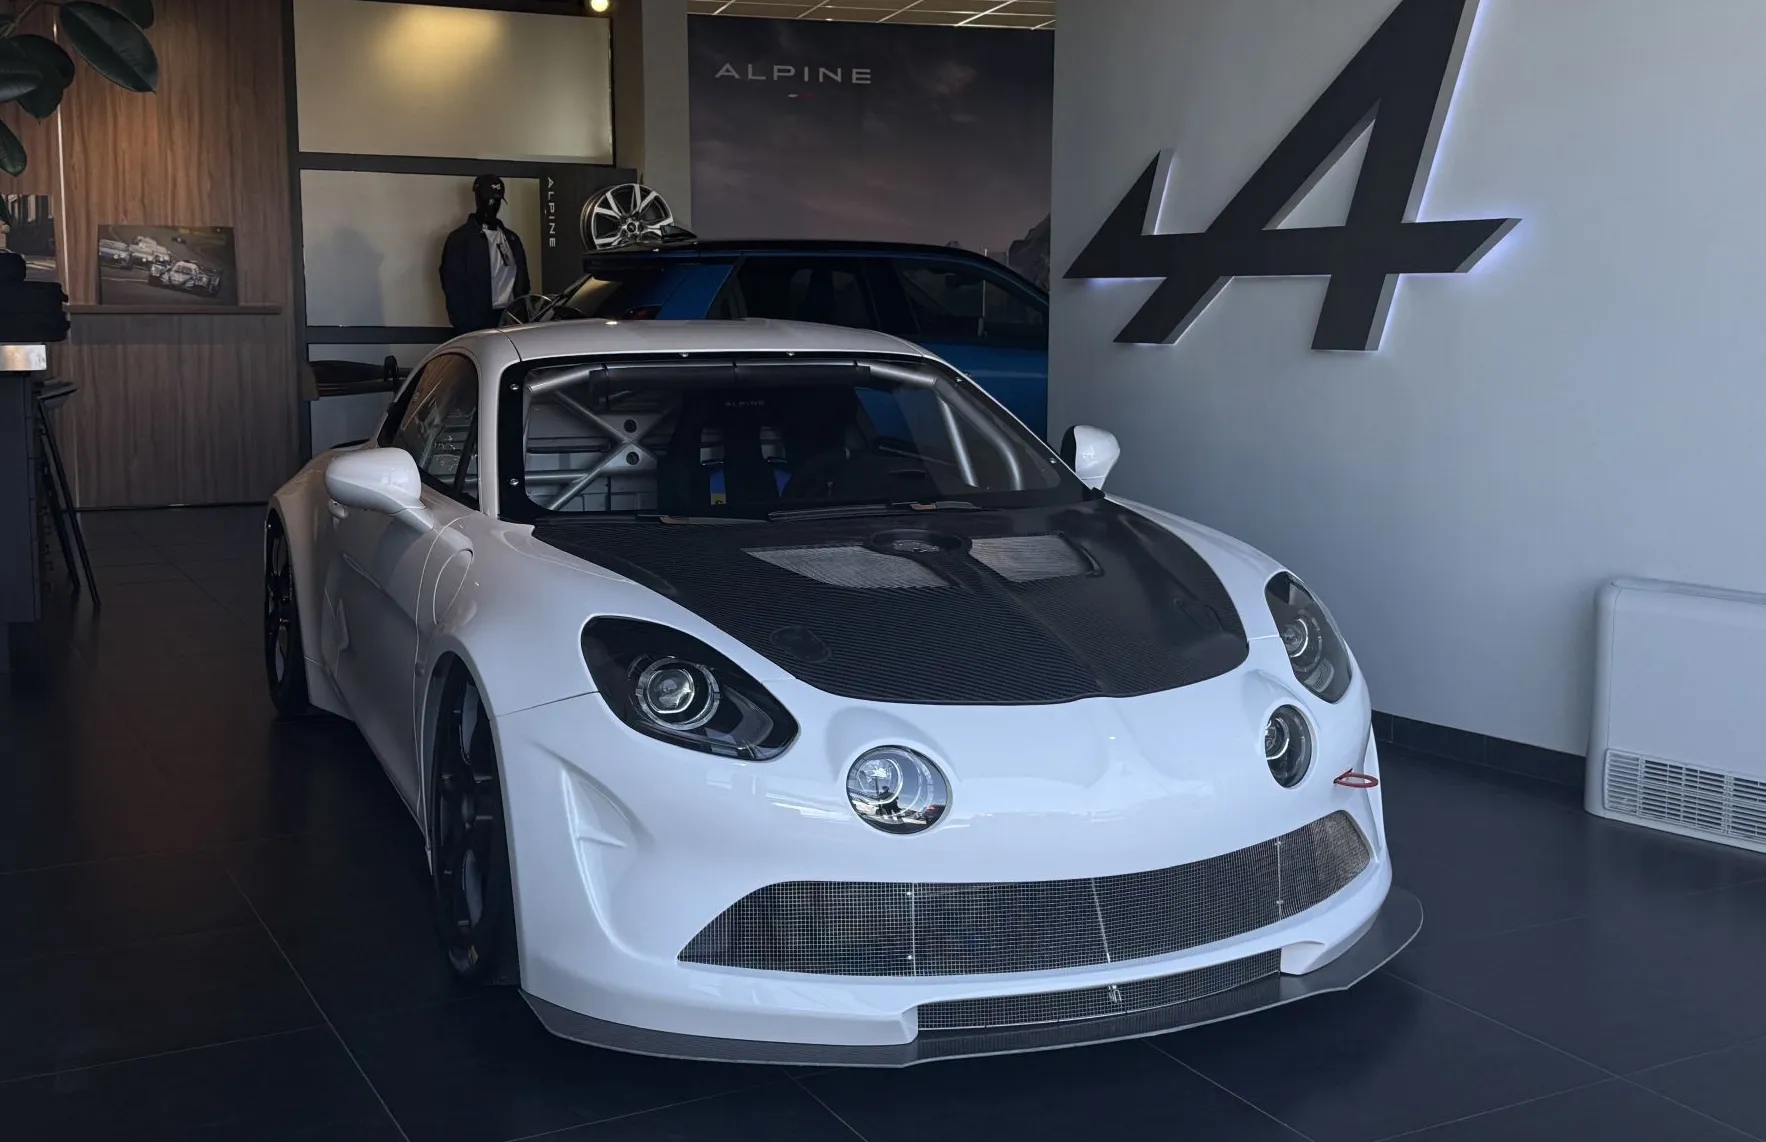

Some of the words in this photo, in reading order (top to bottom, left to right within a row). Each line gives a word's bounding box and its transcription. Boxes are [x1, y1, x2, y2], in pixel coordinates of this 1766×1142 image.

[714, 62, 872, 84] ALPINE
[547, 177, 556, 248] ALPINE
[724, 399, 766, 408] ALPINE
